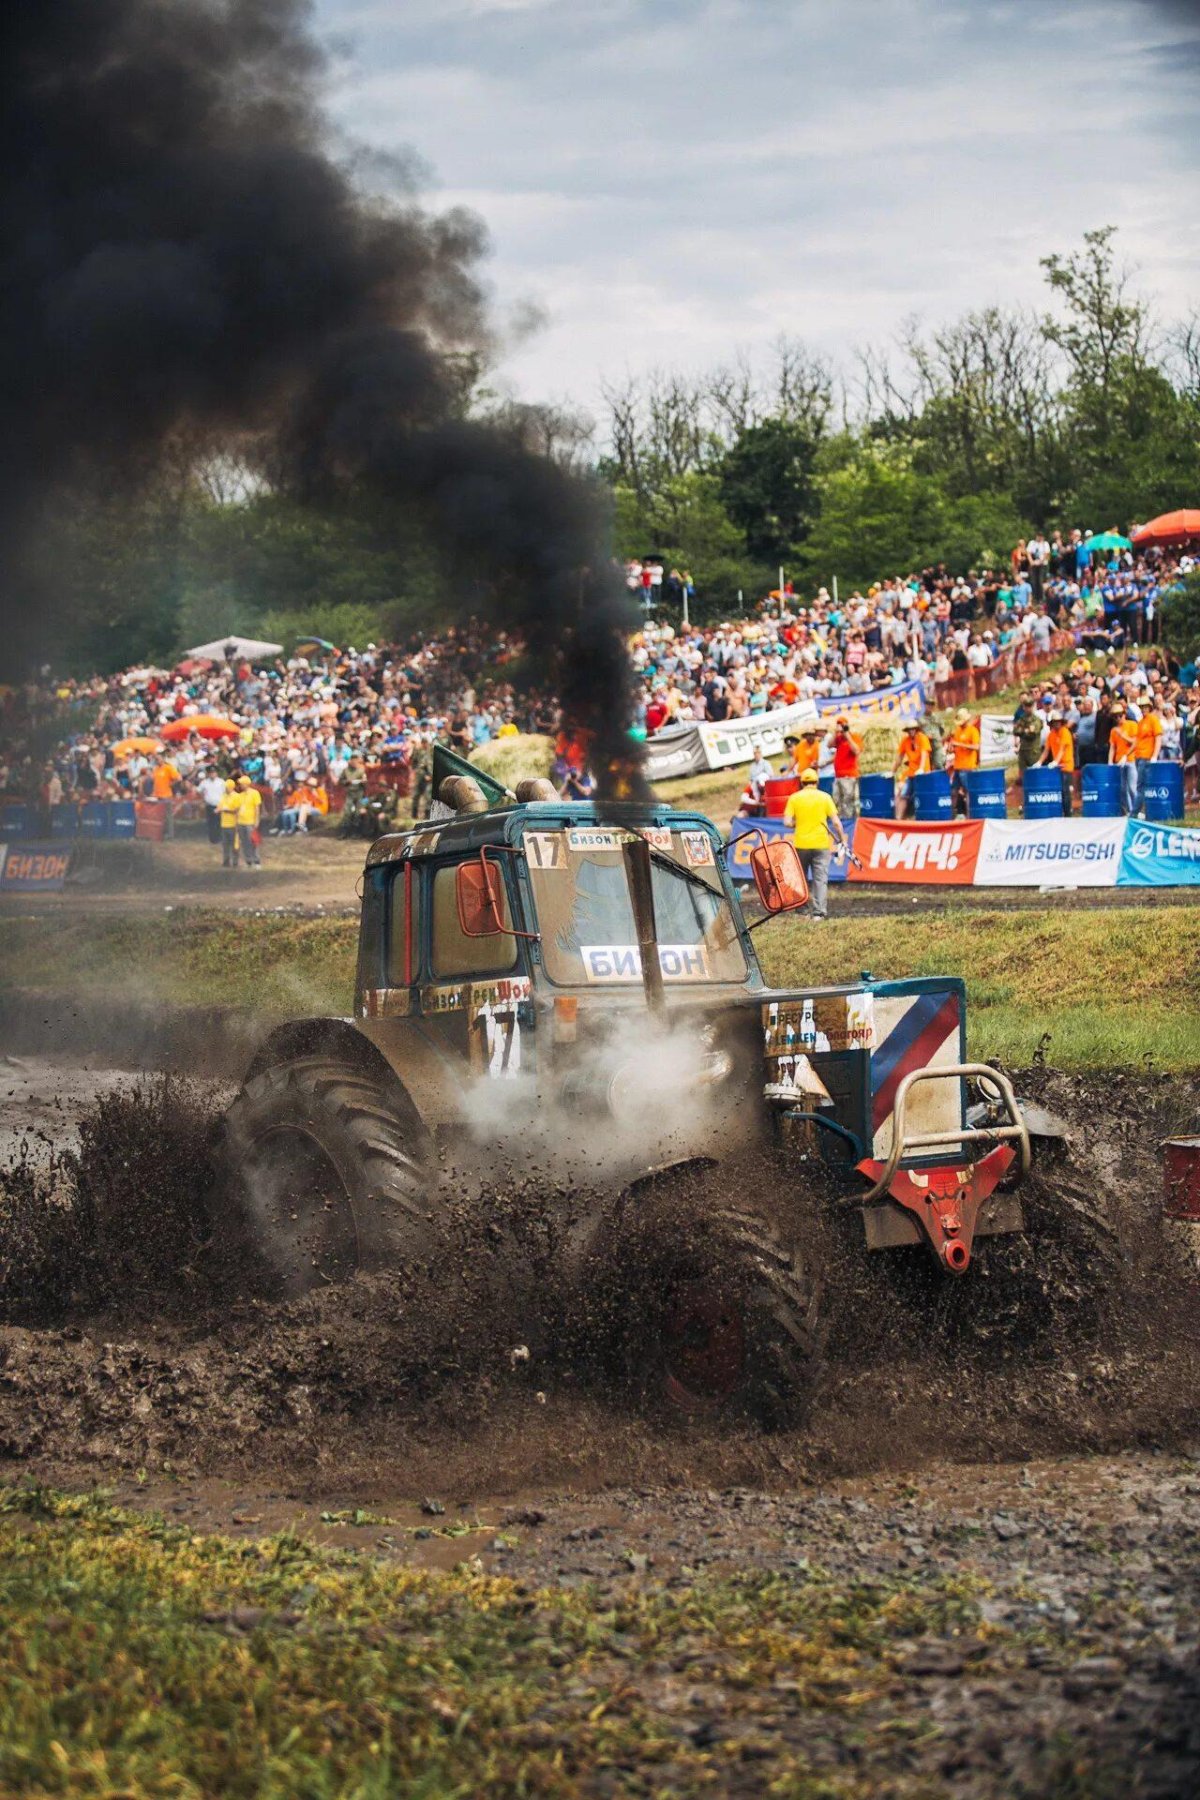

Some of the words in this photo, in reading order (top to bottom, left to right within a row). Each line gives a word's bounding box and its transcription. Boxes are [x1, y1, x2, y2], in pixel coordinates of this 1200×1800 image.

[822, 687, 921, 718] ЗОН
[526, 835, 560, 866] 17
[1004, 843, 1116, 861] MITSUBOSHI
[6, 855, 70, 880] БИЗОН
[589, 950, 706, 977] БИОН
[472, 1011, 516, 1074] 17
